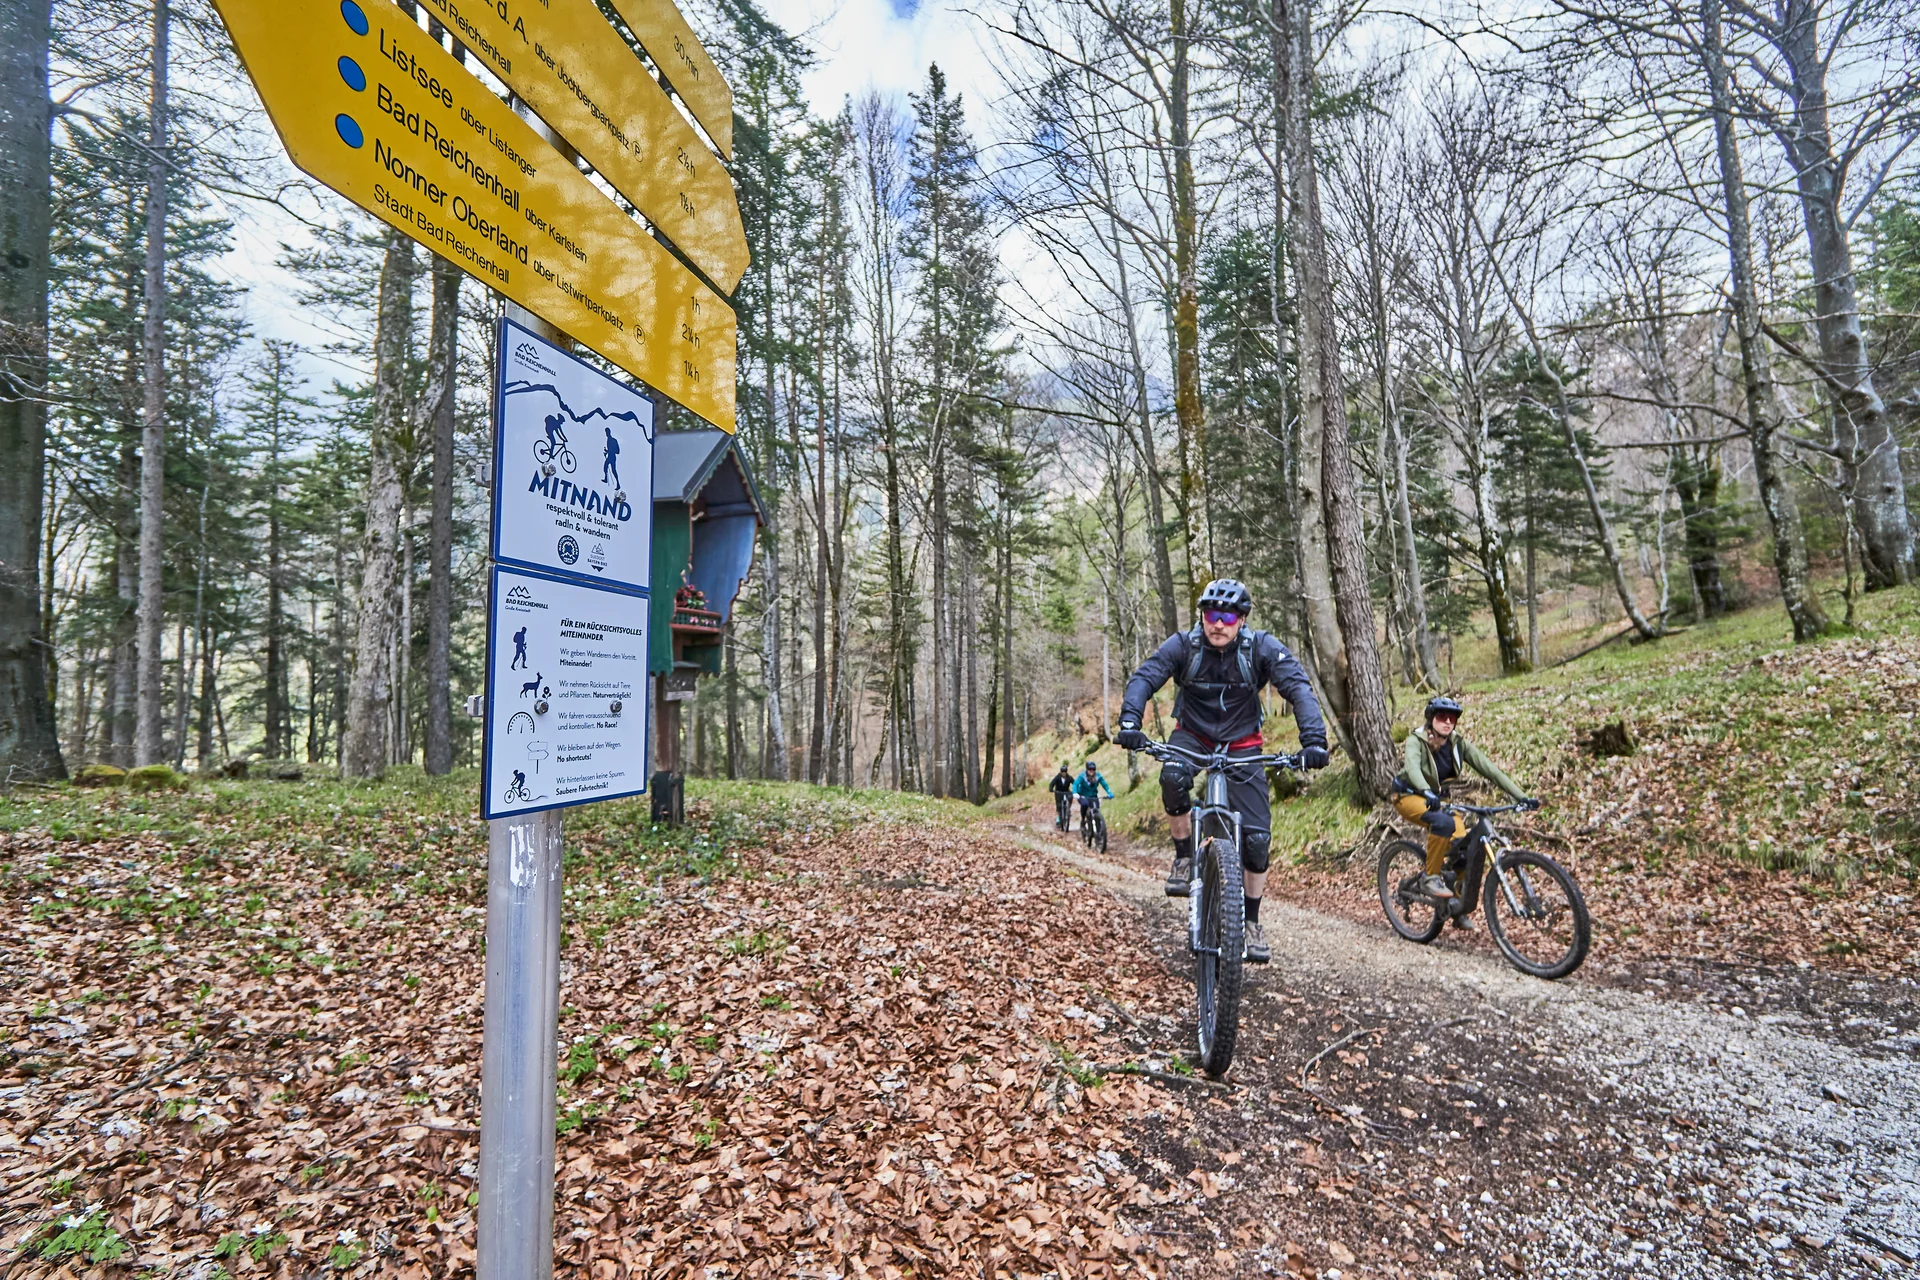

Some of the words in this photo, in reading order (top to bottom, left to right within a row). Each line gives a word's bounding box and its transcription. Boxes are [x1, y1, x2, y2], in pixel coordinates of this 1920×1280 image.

[449, 3, 512, 75] Reichenhall
[674, 35, 685, 60] 30
[685, 55, 699, 81] min
[513, 16, 529, 45] A.
[535, 42, 556, 71] über
[557, 67, 630, 150] Jochbergparkplatz
[380, 28, 453, 108] Listsee
[460, 107, 486, 135] über
[489, 128, 537, 178] Listanger
[377, 83, 419, 135] Bad
[424, 119, 520, 213] Reichenhall
[525, 207, 547, 233] über
[549, 223, 588, 264] Karlstein
[373, 184, 414, 223] Stadt
[416, 216, 444, 242] Bad
[446, 231, 510, 284] Reichenhall
[374, 138, 448, 208] Nonner
[452, 195, 528, 265] Oberland
[533, 259, 555, 283] über
[556, 274, 624, 332] Listwirtparkplatz
[528, 469, 632, 522] MITNAND
[546, 503, 586, 521] respektvoll
[586, 514, 593, 523] &
[593, 516, 619, 531] tolerant
[555, 518, 574, 530] radln
[575, 523, 581, 532] &
[582, 526, 611, 540] wandern
[561, 617, 574, 628] FÜR
[587, 621, 642, 636] RÜCKSICHTSVOLLES
[561, 630, 604, 641] MITEINANDER
[560, 658, 593, 668] Miteinander!
[571, 649, 586, 658] geben
[590, 680, 612, 689] Rücksicht
[566, 753, 592, 763] shortcuts!
[556, 787, 578, 796] Saubere
[579, 781, 609, 793] Fahrtechnik!
